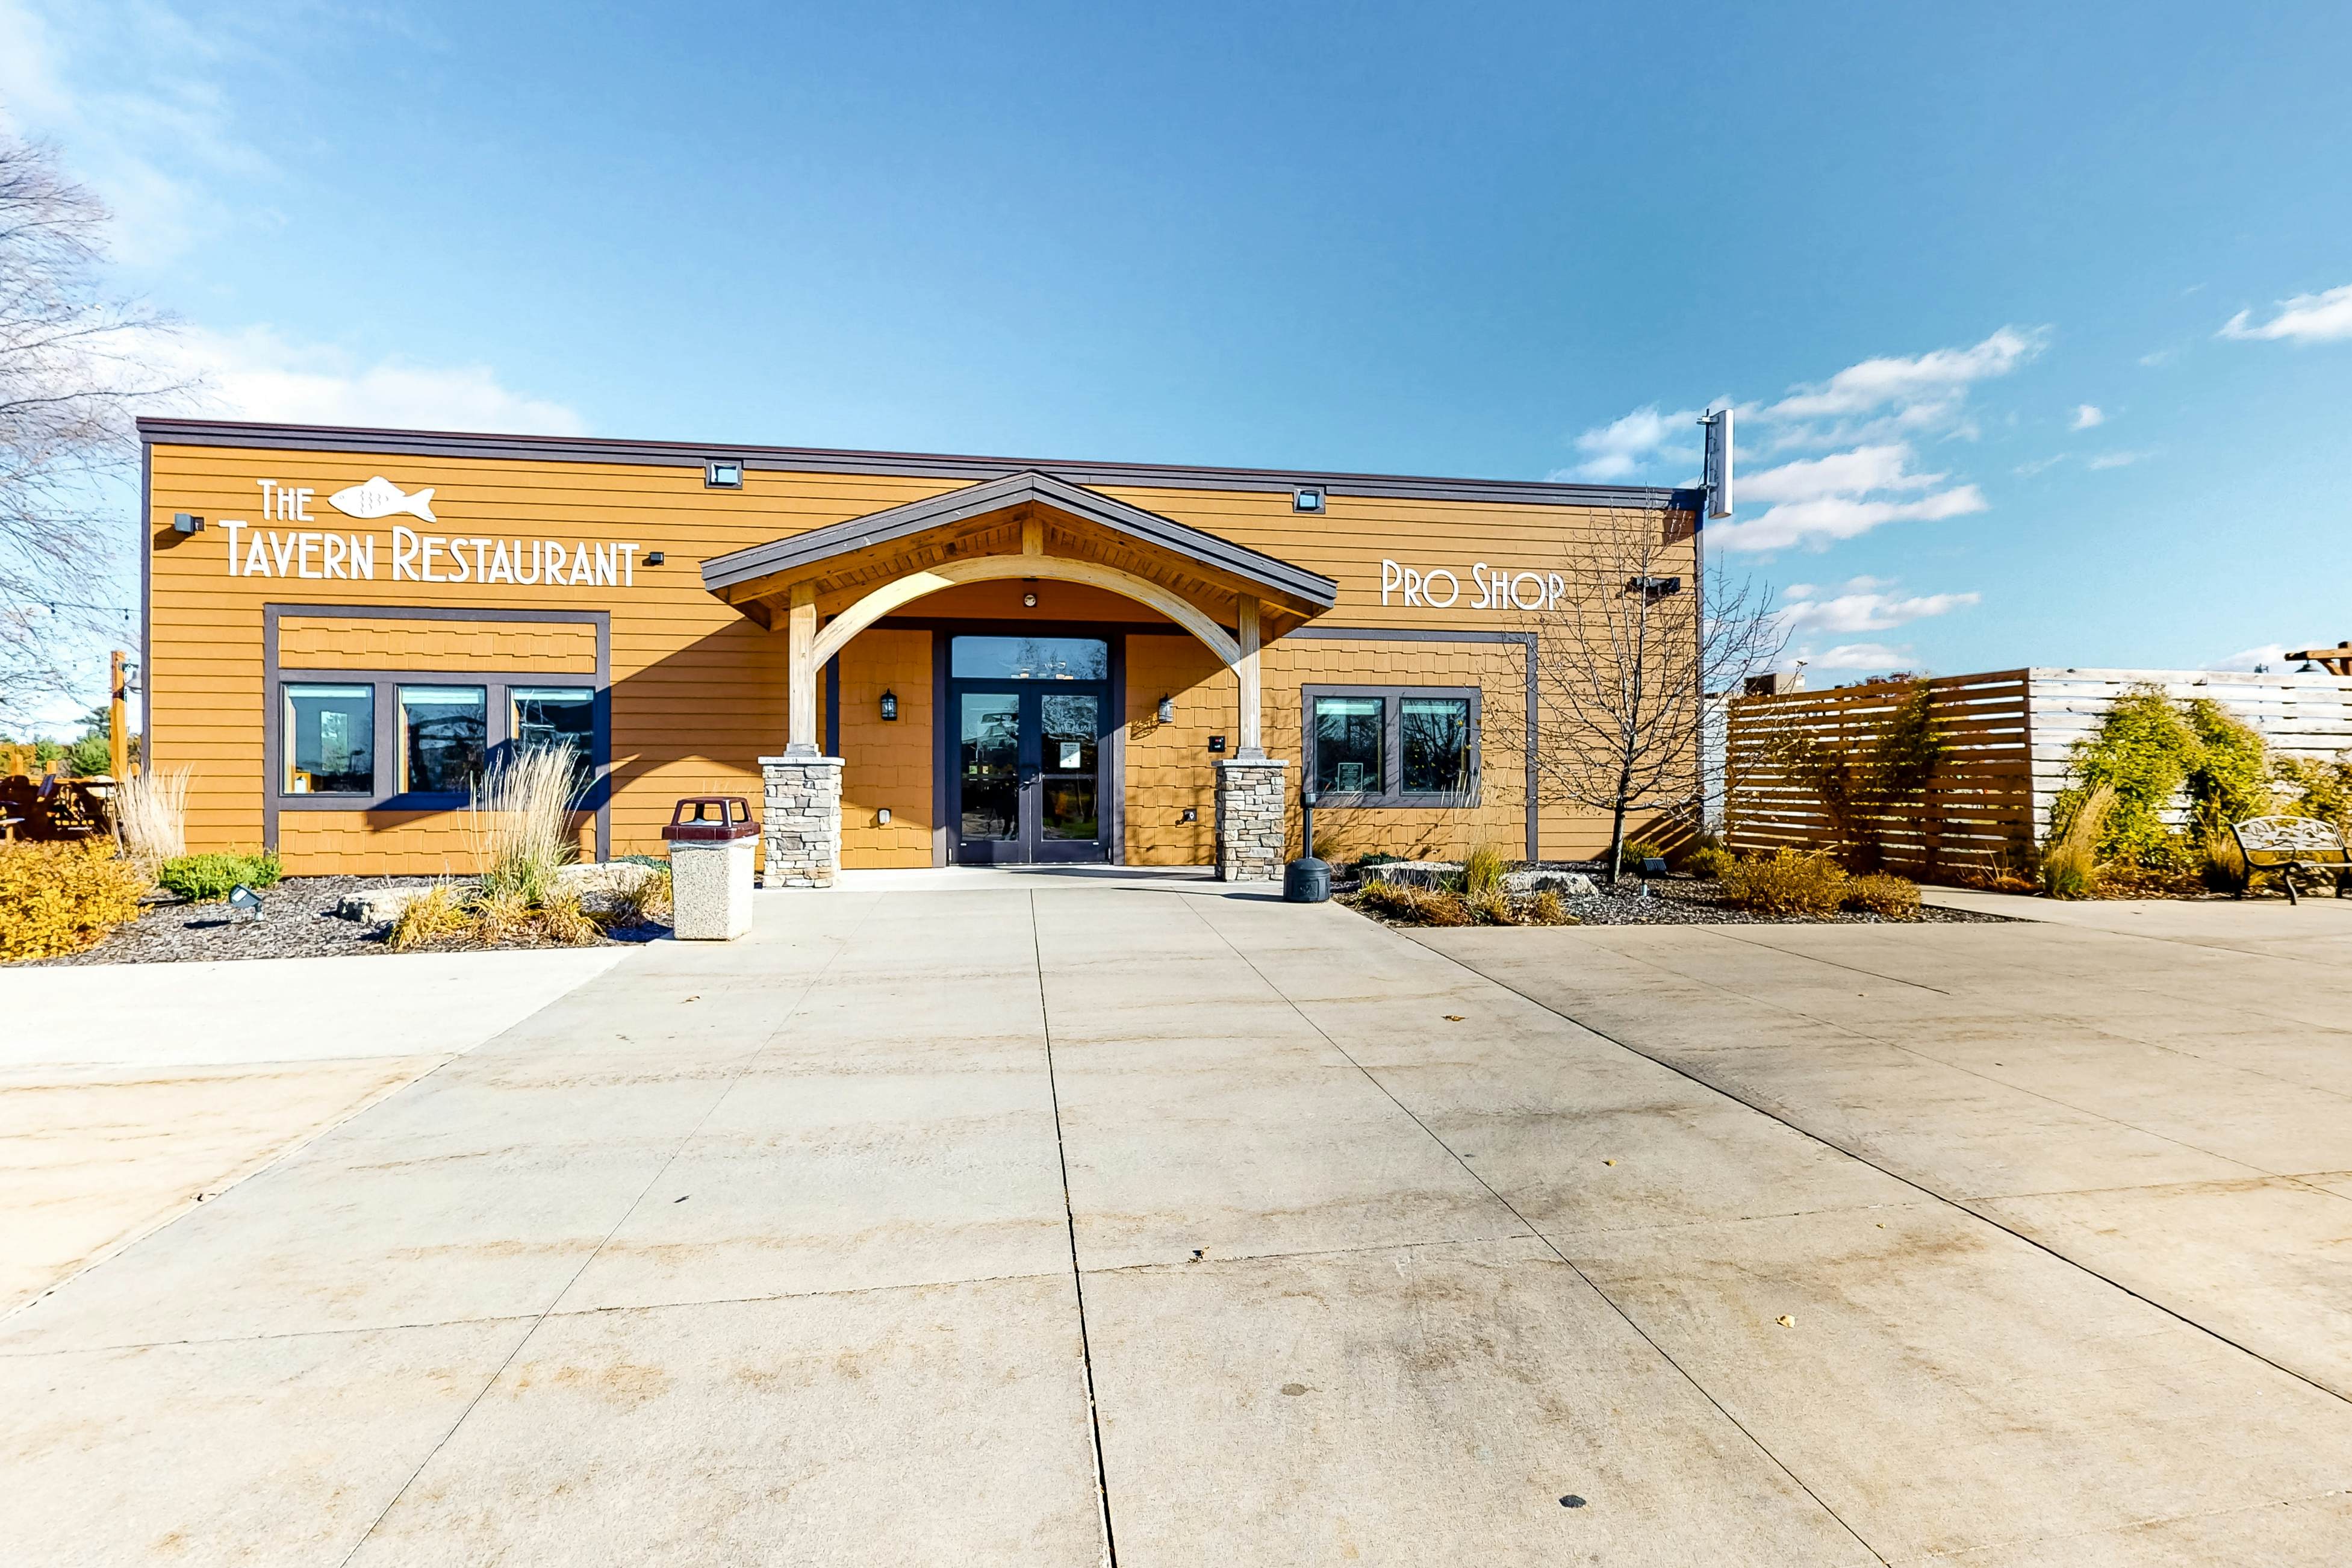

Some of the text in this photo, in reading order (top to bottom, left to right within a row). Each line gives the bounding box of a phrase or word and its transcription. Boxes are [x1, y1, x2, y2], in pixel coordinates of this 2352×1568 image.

[257, 479, 315, 521] THE
[218, 520, 640, 586] TAVERN RESTAURANT
[1381, 559, 1565, 611] PRO SHOP
